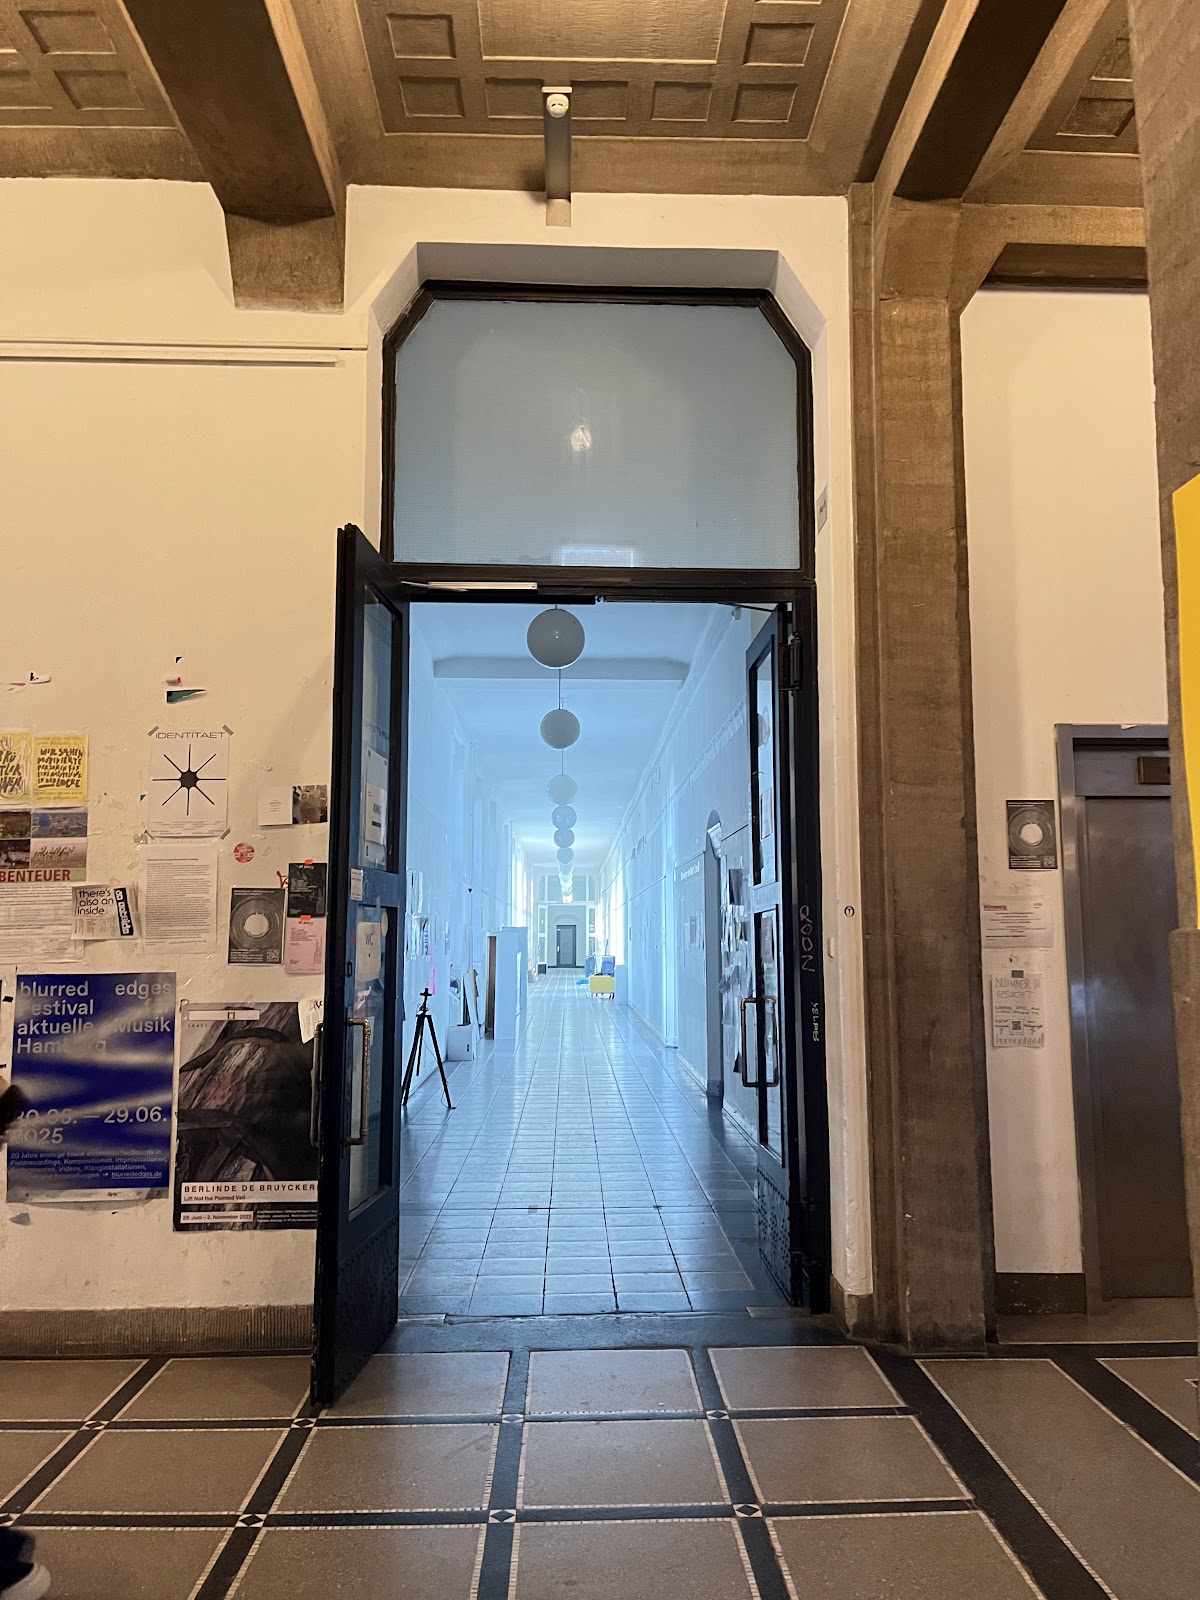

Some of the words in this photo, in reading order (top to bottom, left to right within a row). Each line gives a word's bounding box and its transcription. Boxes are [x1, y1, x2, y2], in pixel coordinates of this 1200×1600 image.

[155, 731, 226, 739] IDENTITAET
[79, 887, 112, 898] there's
[79, 898, 99, 906] also
[77, 906, 105, 915] inside
[20, 980, 89, 997] blurred
[115, 980, 172, 1000] edges
[18, 999, 94, 1016] estival
[17, 1018, 94, 1035] aktuelle
[113, 1017, 171, 1033] Musik
[16, 1038, 107, 1054] Hamg
[104, 1106, 168, 1124] 29.06.
[184, 1185, 237, 1193] BERLINDE
[242, 1184, 255, 1192] DE
[259, 1183, 318, 1192] BRUYCKER
